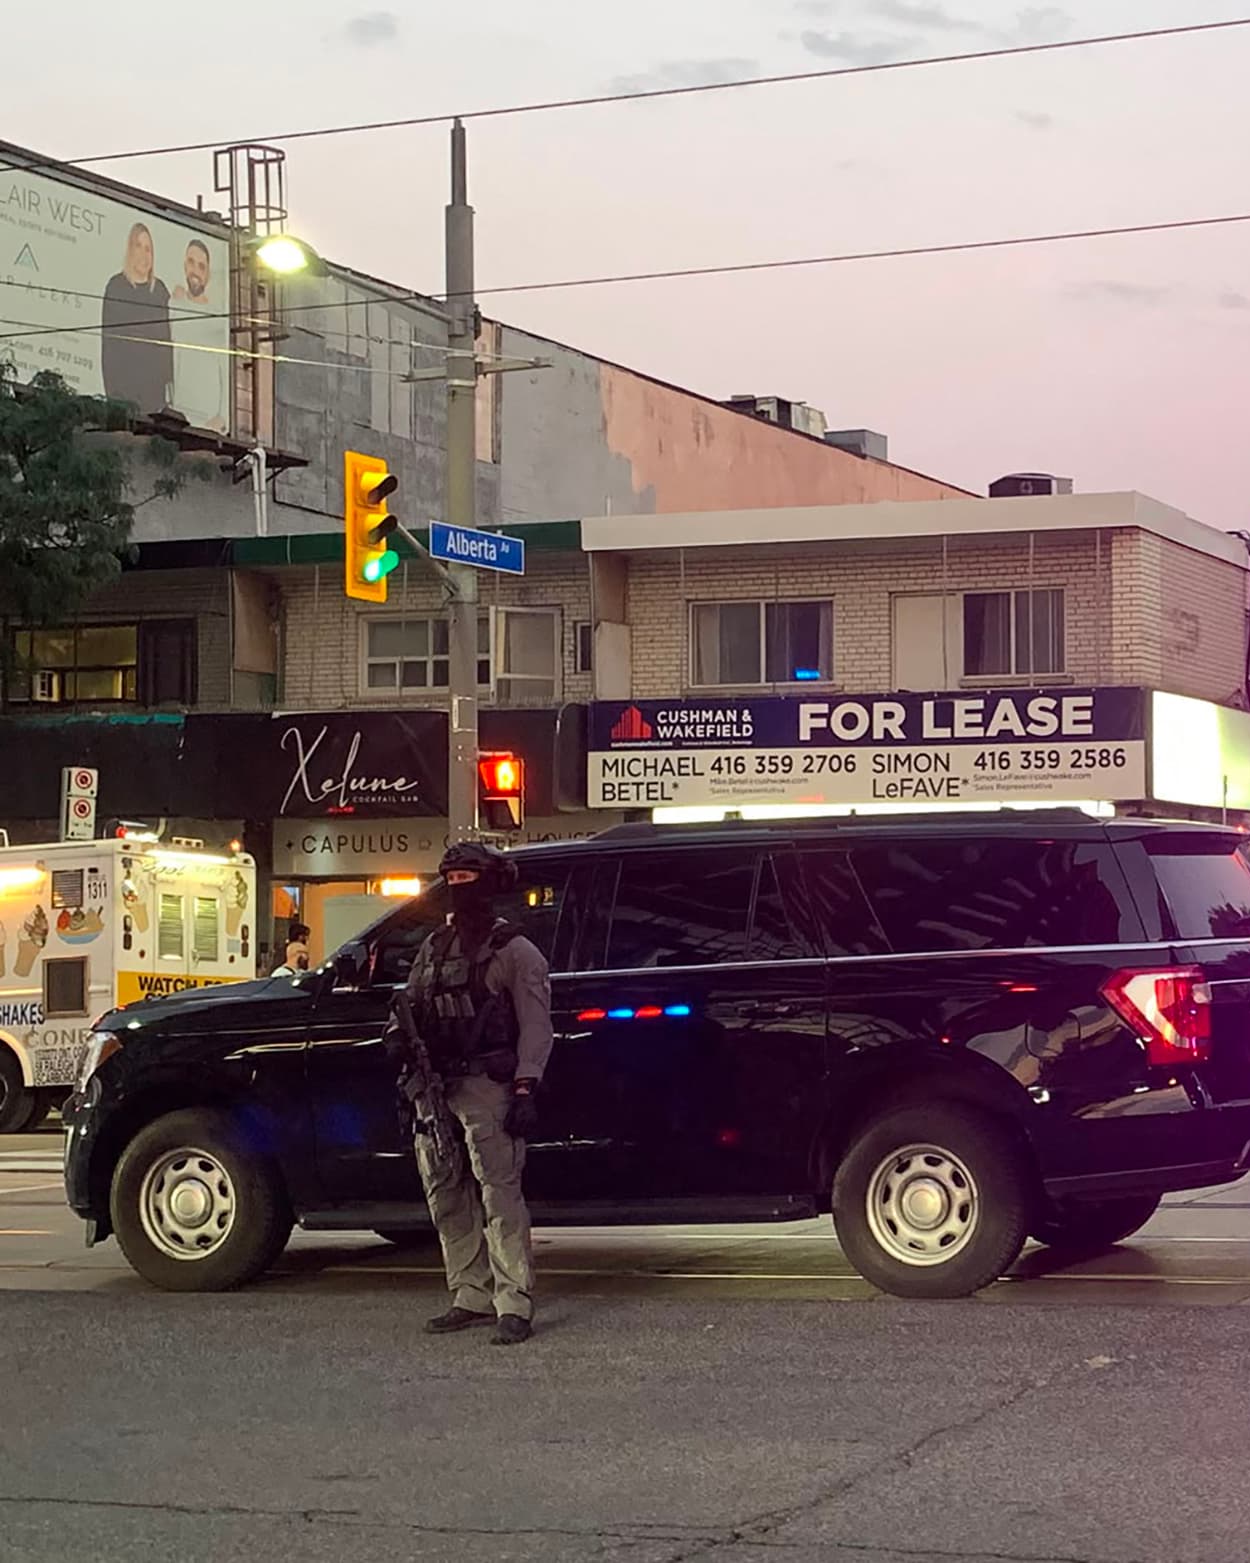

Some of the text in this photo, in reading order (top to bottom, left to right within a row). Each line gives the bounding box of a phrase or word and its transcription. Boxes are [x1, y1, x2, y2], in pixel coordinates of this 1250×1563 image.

[47, 197, 106, 235] WEST
[446, 530, 497, 560] Alberta
[657, 709, 752, 723] CUSHMAN &
[800, 696, 1093, 740] FOR LEASE
[657, 724, 753, 738] WAKEFIELD
[602, 753, 857, 778] MICHAEL 416 359 2706
[872, 748, 1126, 773] SIMON 416 359 2586
[302, 834, 408, 853] CAPULUS
[138, 976, 198, 993] WATCH
[0, 1003, 45, 1026] HAKES
